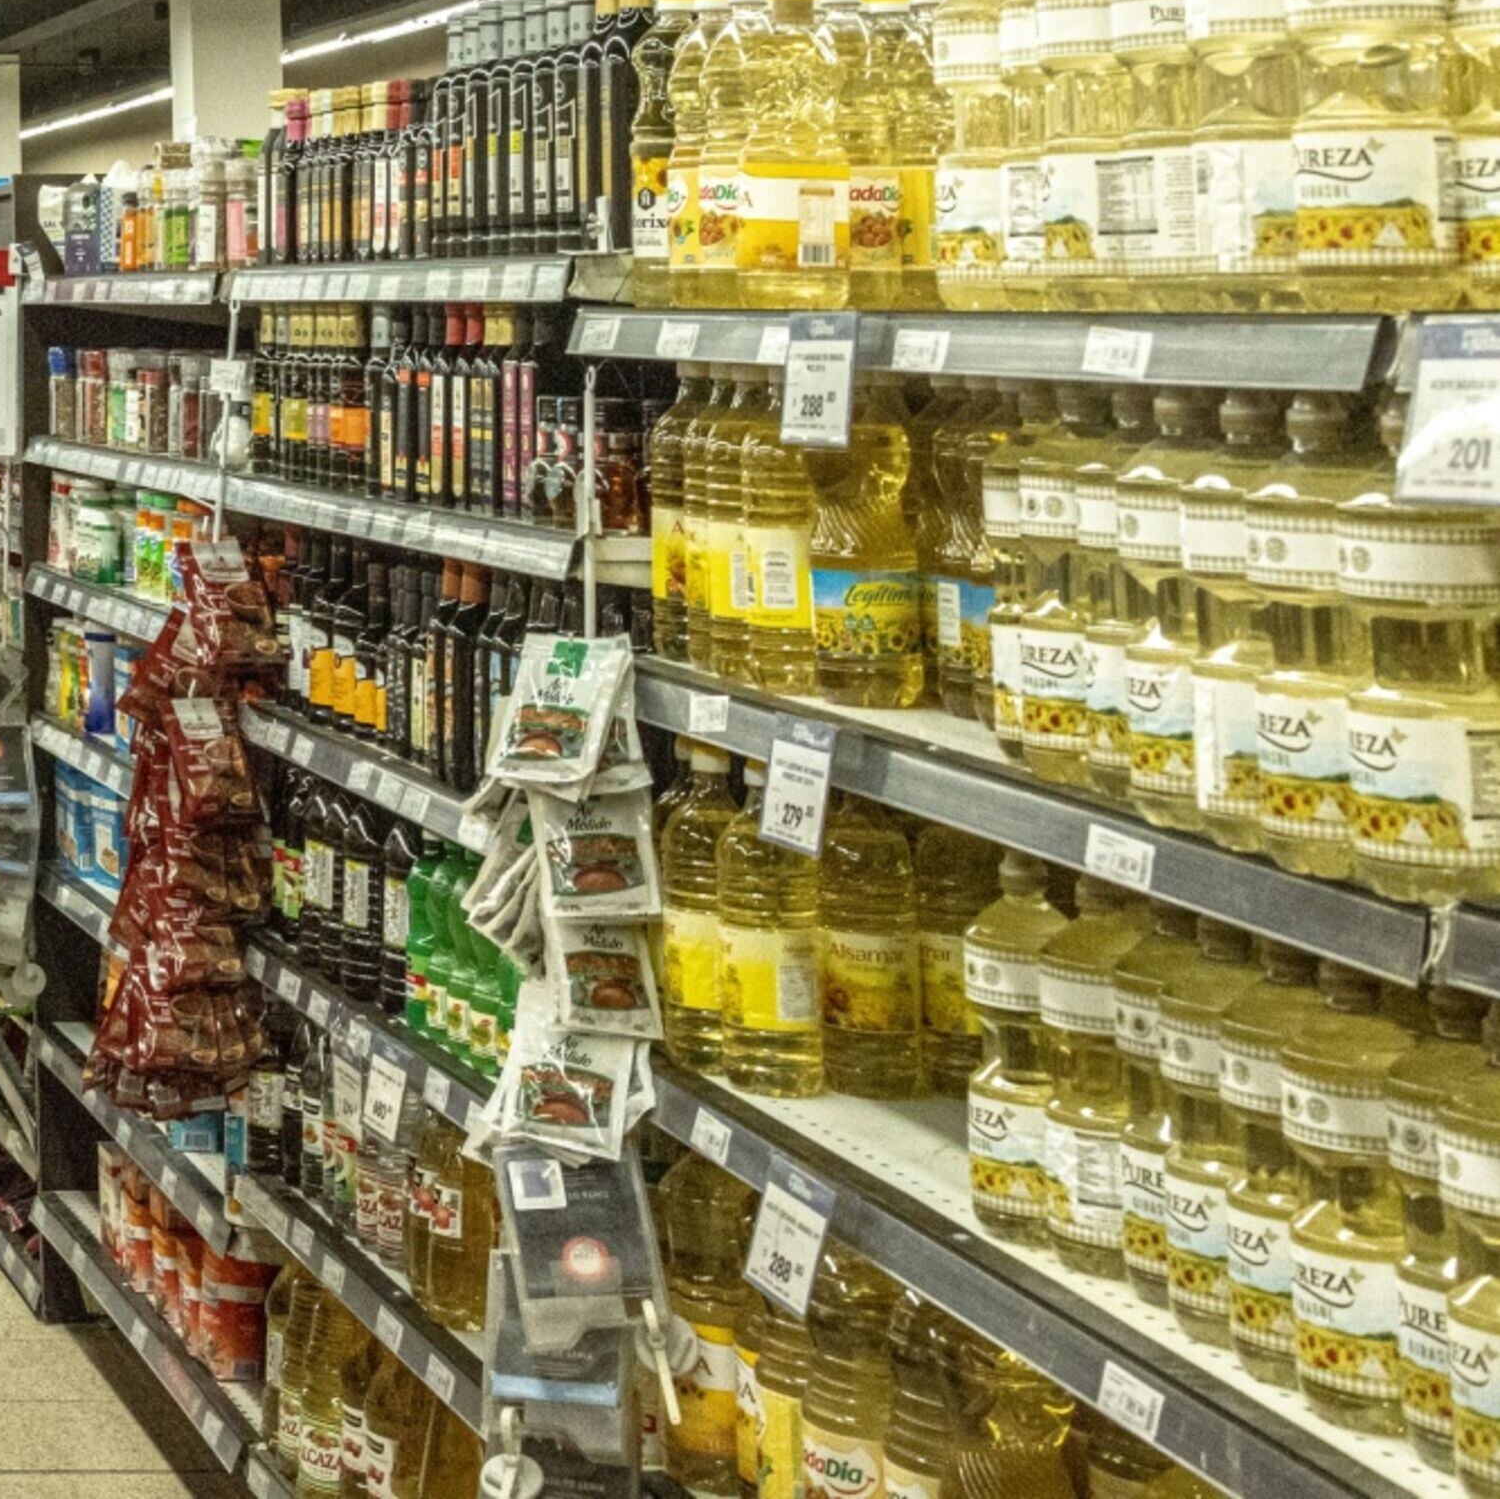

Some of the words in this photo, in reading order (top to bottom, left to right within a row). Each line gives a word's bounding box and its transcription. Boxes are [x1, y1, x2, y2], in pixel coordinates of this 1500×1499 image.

[1150, 3, 1185, 21] PUR
[1299, 145, 1374, 170] UREZA
[1258, 711, 1313, 740] REZA
[1121, 1153, 1164, 1191] PURE
[1298, 1265, 1354, 1297] REZA
[1399, 1290, 1447, 1333] PURE
